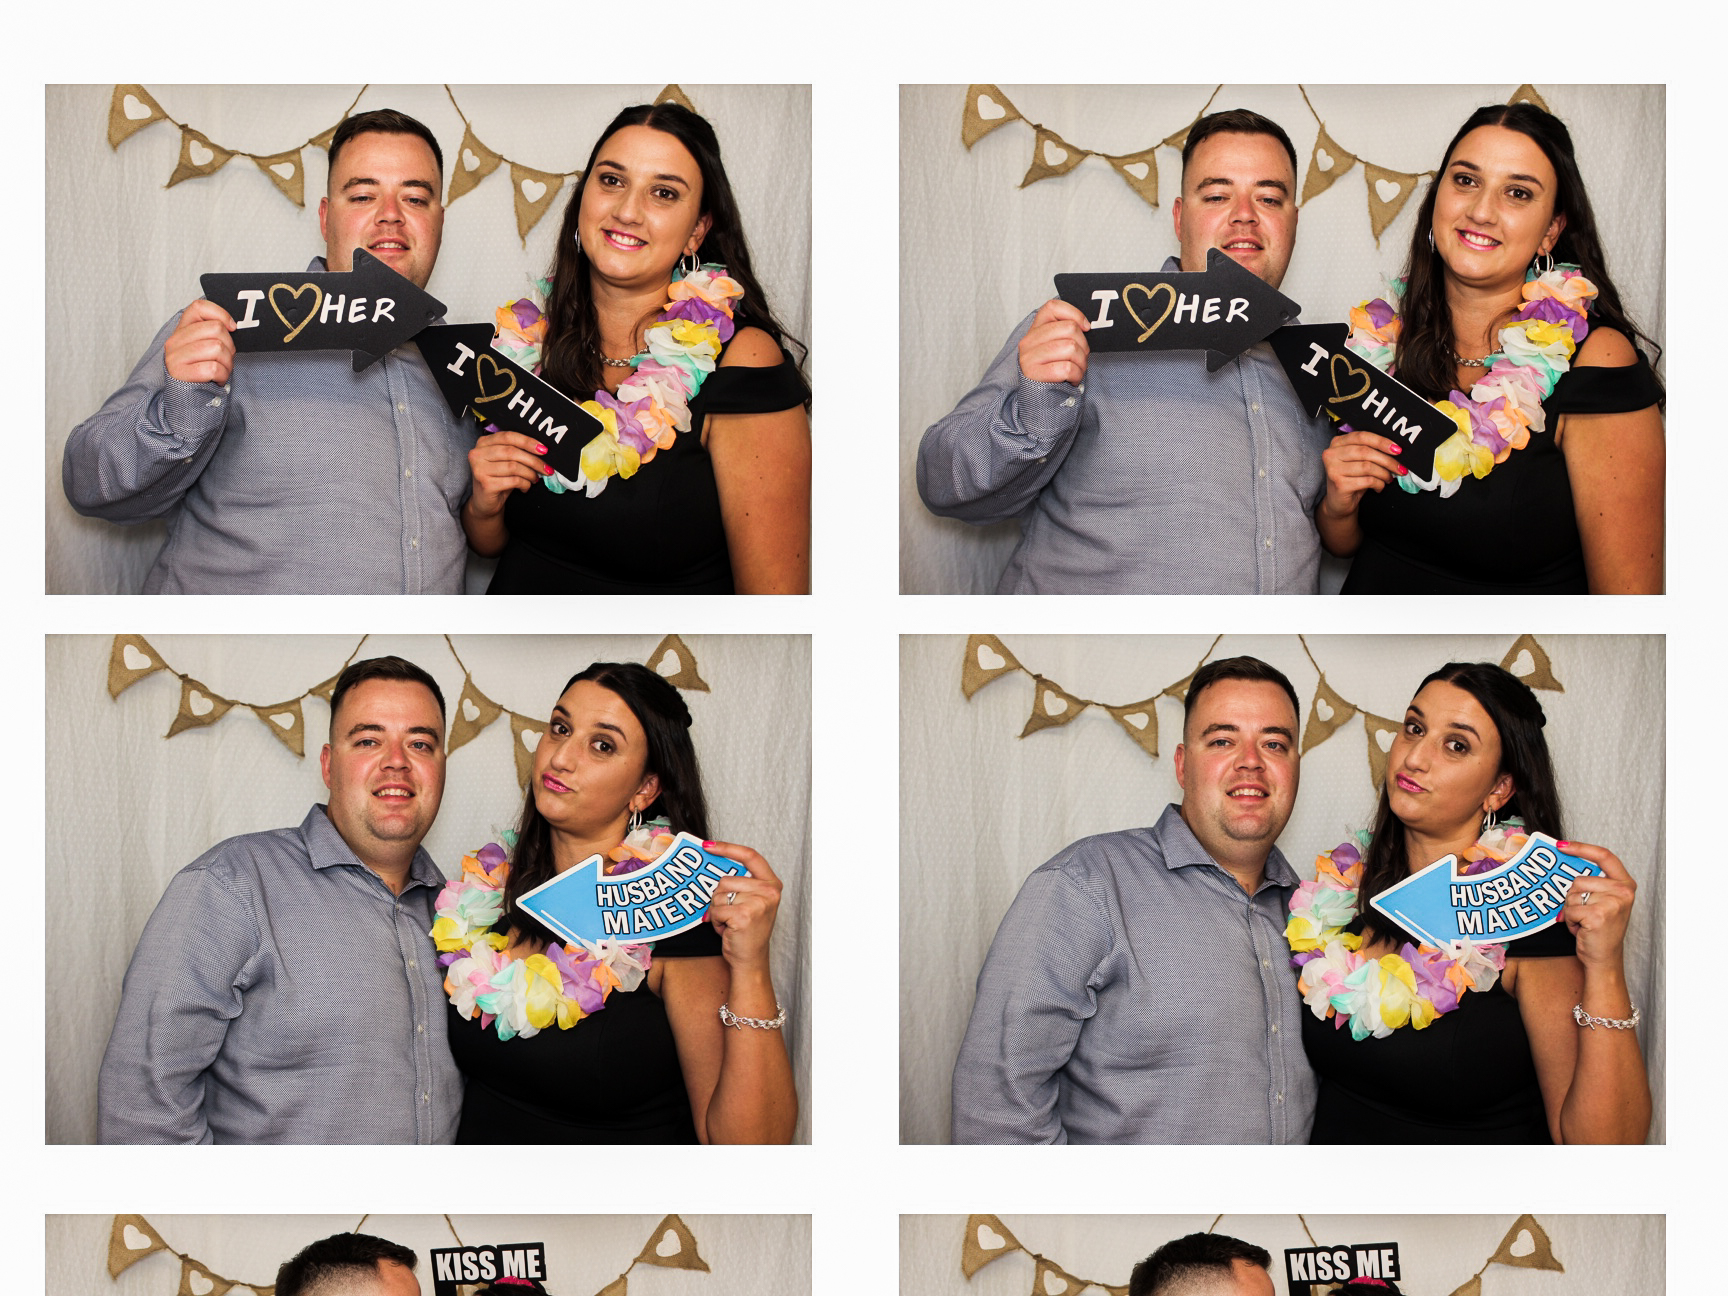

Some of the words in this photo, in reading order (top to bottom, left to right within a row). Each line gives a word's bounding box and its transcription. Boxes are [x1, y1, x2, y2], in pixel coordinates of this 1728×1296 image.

[234, 290, 265, 329] I
[320, 292, 395, 323] HER
[1088, 290, 1119, 329] I
[1174, 292, 1249, 323] HER
[446, 342, 475, 377] I
[507, 388, 569, 444] HIM
[1300, 342, 1329, 377] I
[1361, 388, 1423, 444] HIM
[597, 847, 703, 907] HUSBAND
[602, 862, 738, 934] MATERIAL
[1451, 847, 1557, 907] HUSBAND
[1456, 862, 1592, 934] MATERIAL
[435, 1250, 497, 1282] KISS
[502, 1249, 542, 1278] ME
[1289, 1250, 1351, 1282] KISS
[1356, 1249, 1396, 1278] ME
